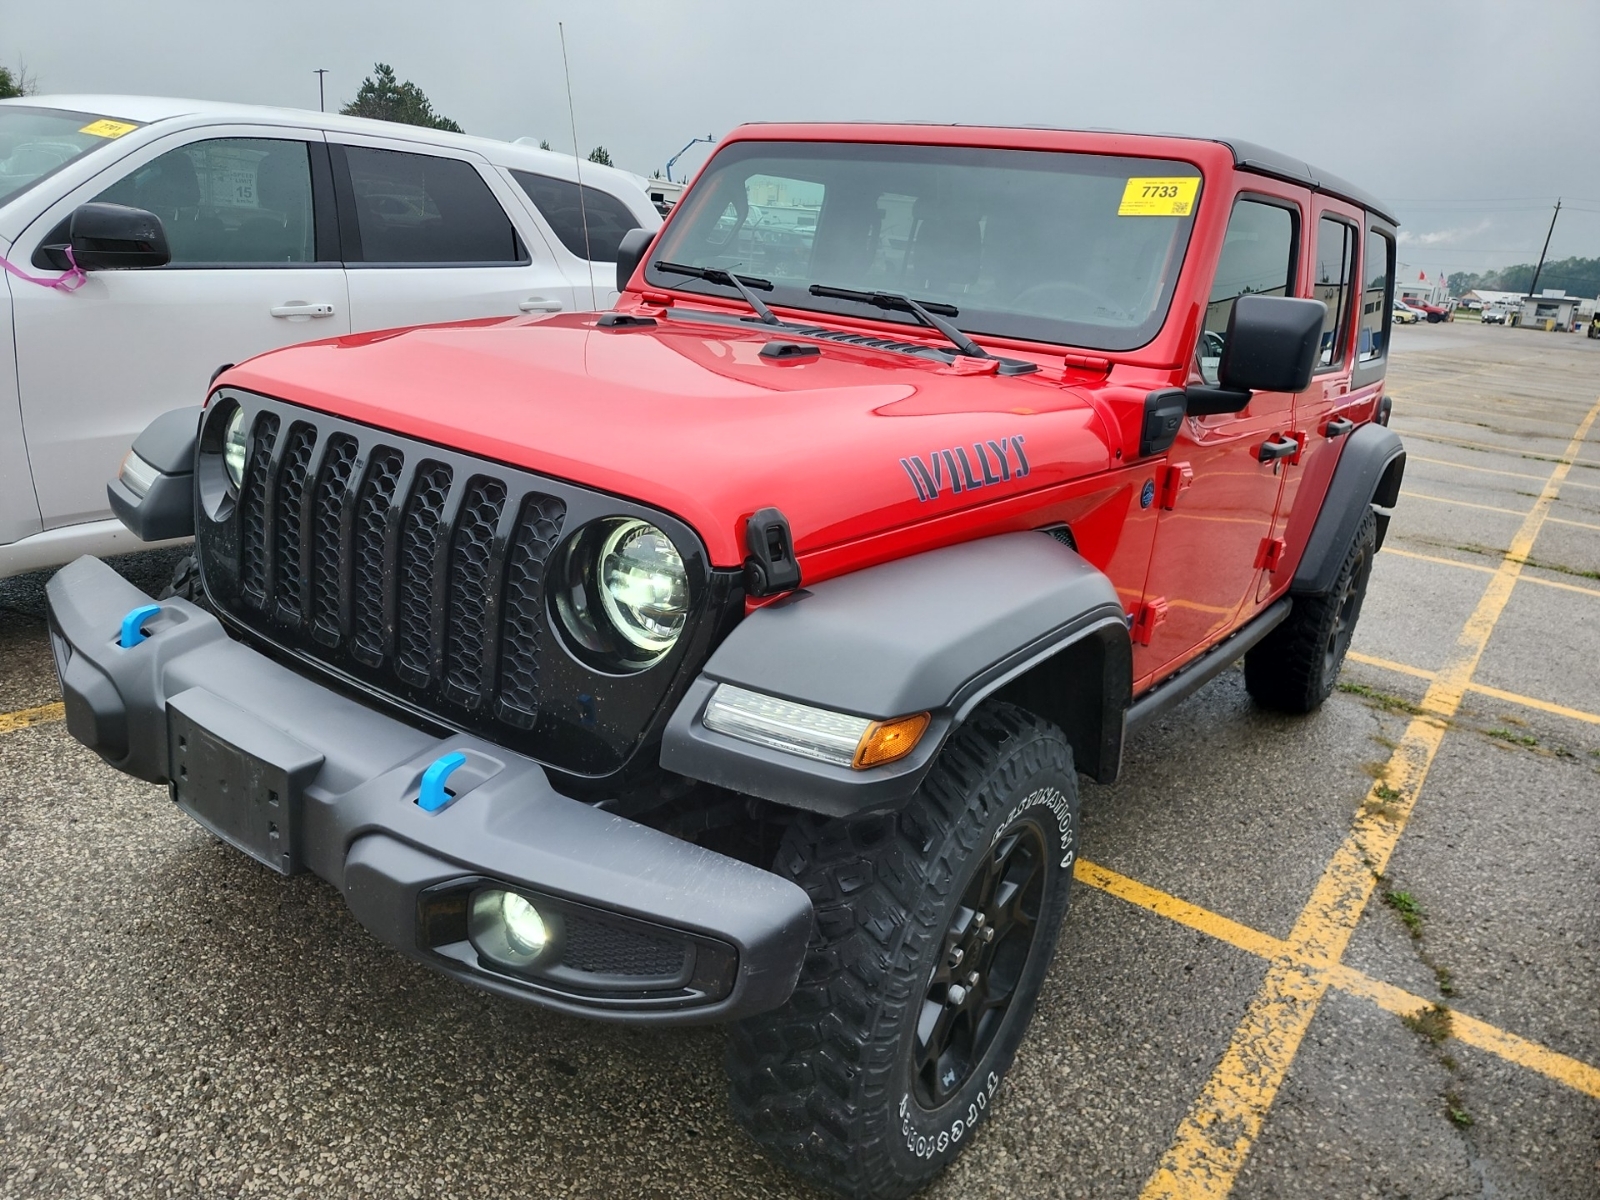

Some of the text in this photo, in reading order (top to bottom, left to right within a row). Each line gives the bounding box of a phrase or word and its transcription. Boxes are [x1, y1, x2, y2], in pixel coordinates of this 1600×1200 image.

[236, 186, 252, 199] 15
[1142, 186, 1178, 198] 7733
[899, 434, 1031, 503] WILLYS
